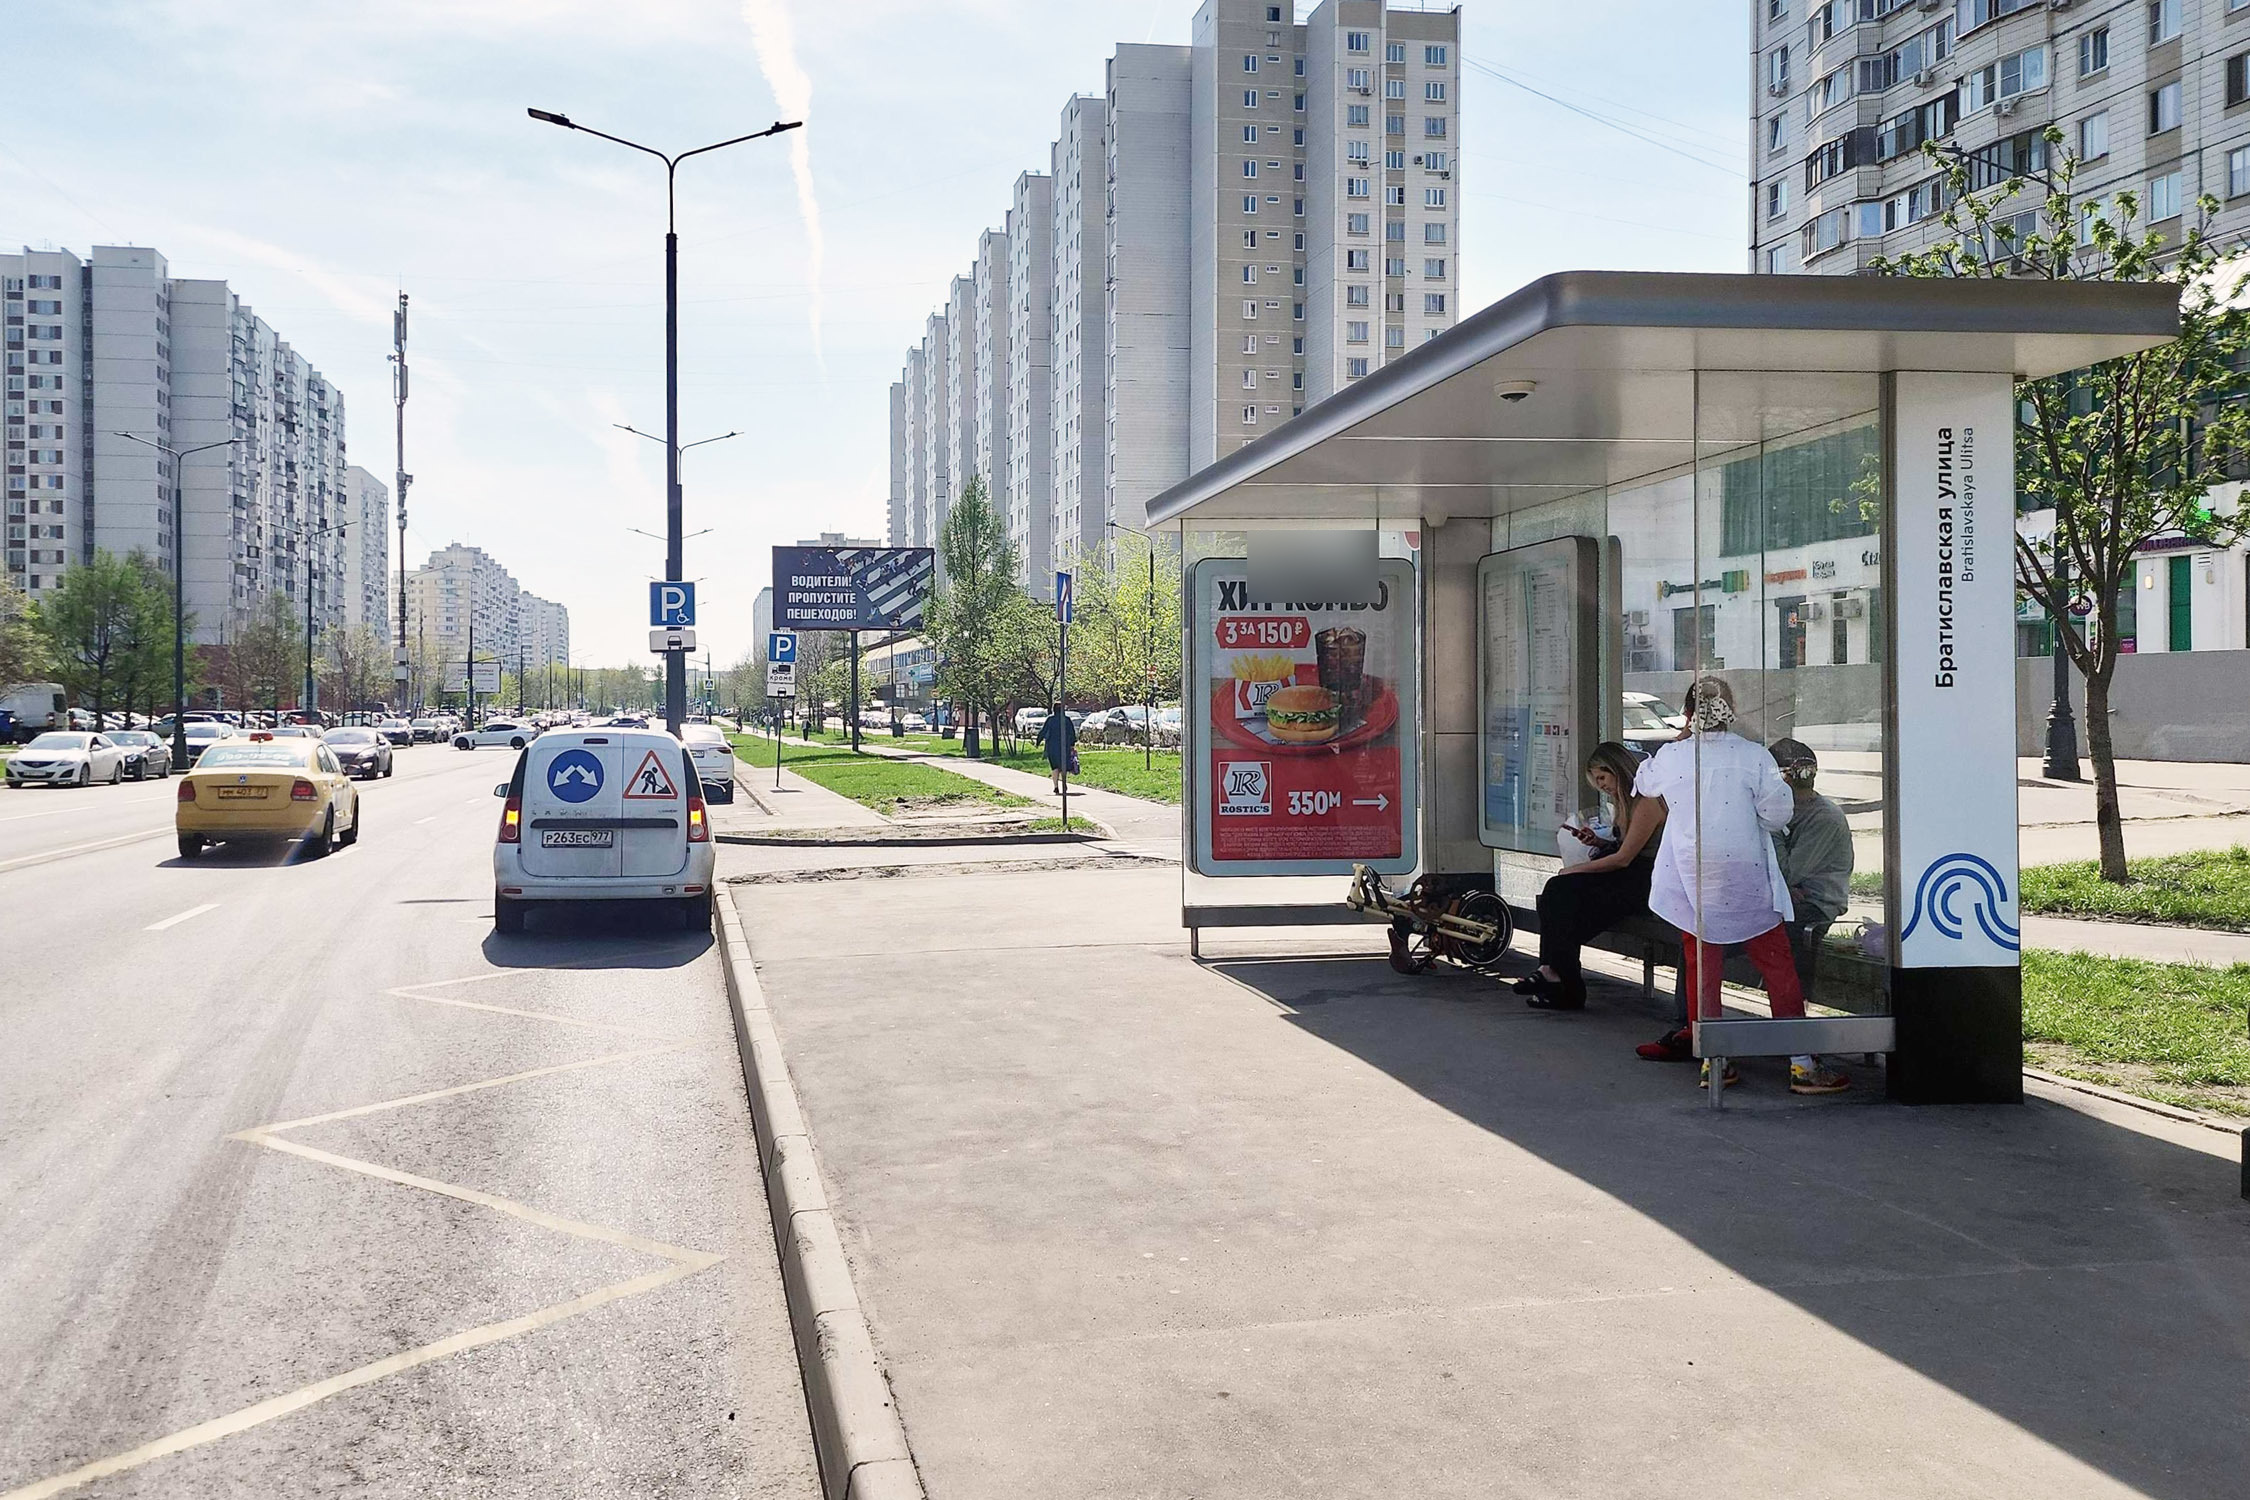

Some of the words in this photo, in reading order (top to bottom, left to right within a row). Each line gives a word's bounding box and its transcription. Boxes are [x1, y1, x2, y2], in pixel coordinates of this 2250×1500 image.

[1960, 428, 1974, 470] Ulitsa
[1937, 428, 1956, 498] улица
[1960, 475, 1976, 582] Bratislavskaya
[791, 575, 852, 588] ВОДИТЕЛИ!
[661, 586, 686, 622] P
[788, 592, 857, 604] ПРОПУСТИТЕ
[1218, 581, 1273, 611] ХИ
[1935, 508, 1958, 688] Братиславская
[786, 608, 857, 621] ПЕШЕХОДОВ!
[1225, 622, 1238, 644] 3
[775, 636, 792, 660] P
[1221, 805, 1270, 814] ROSTIC'S
